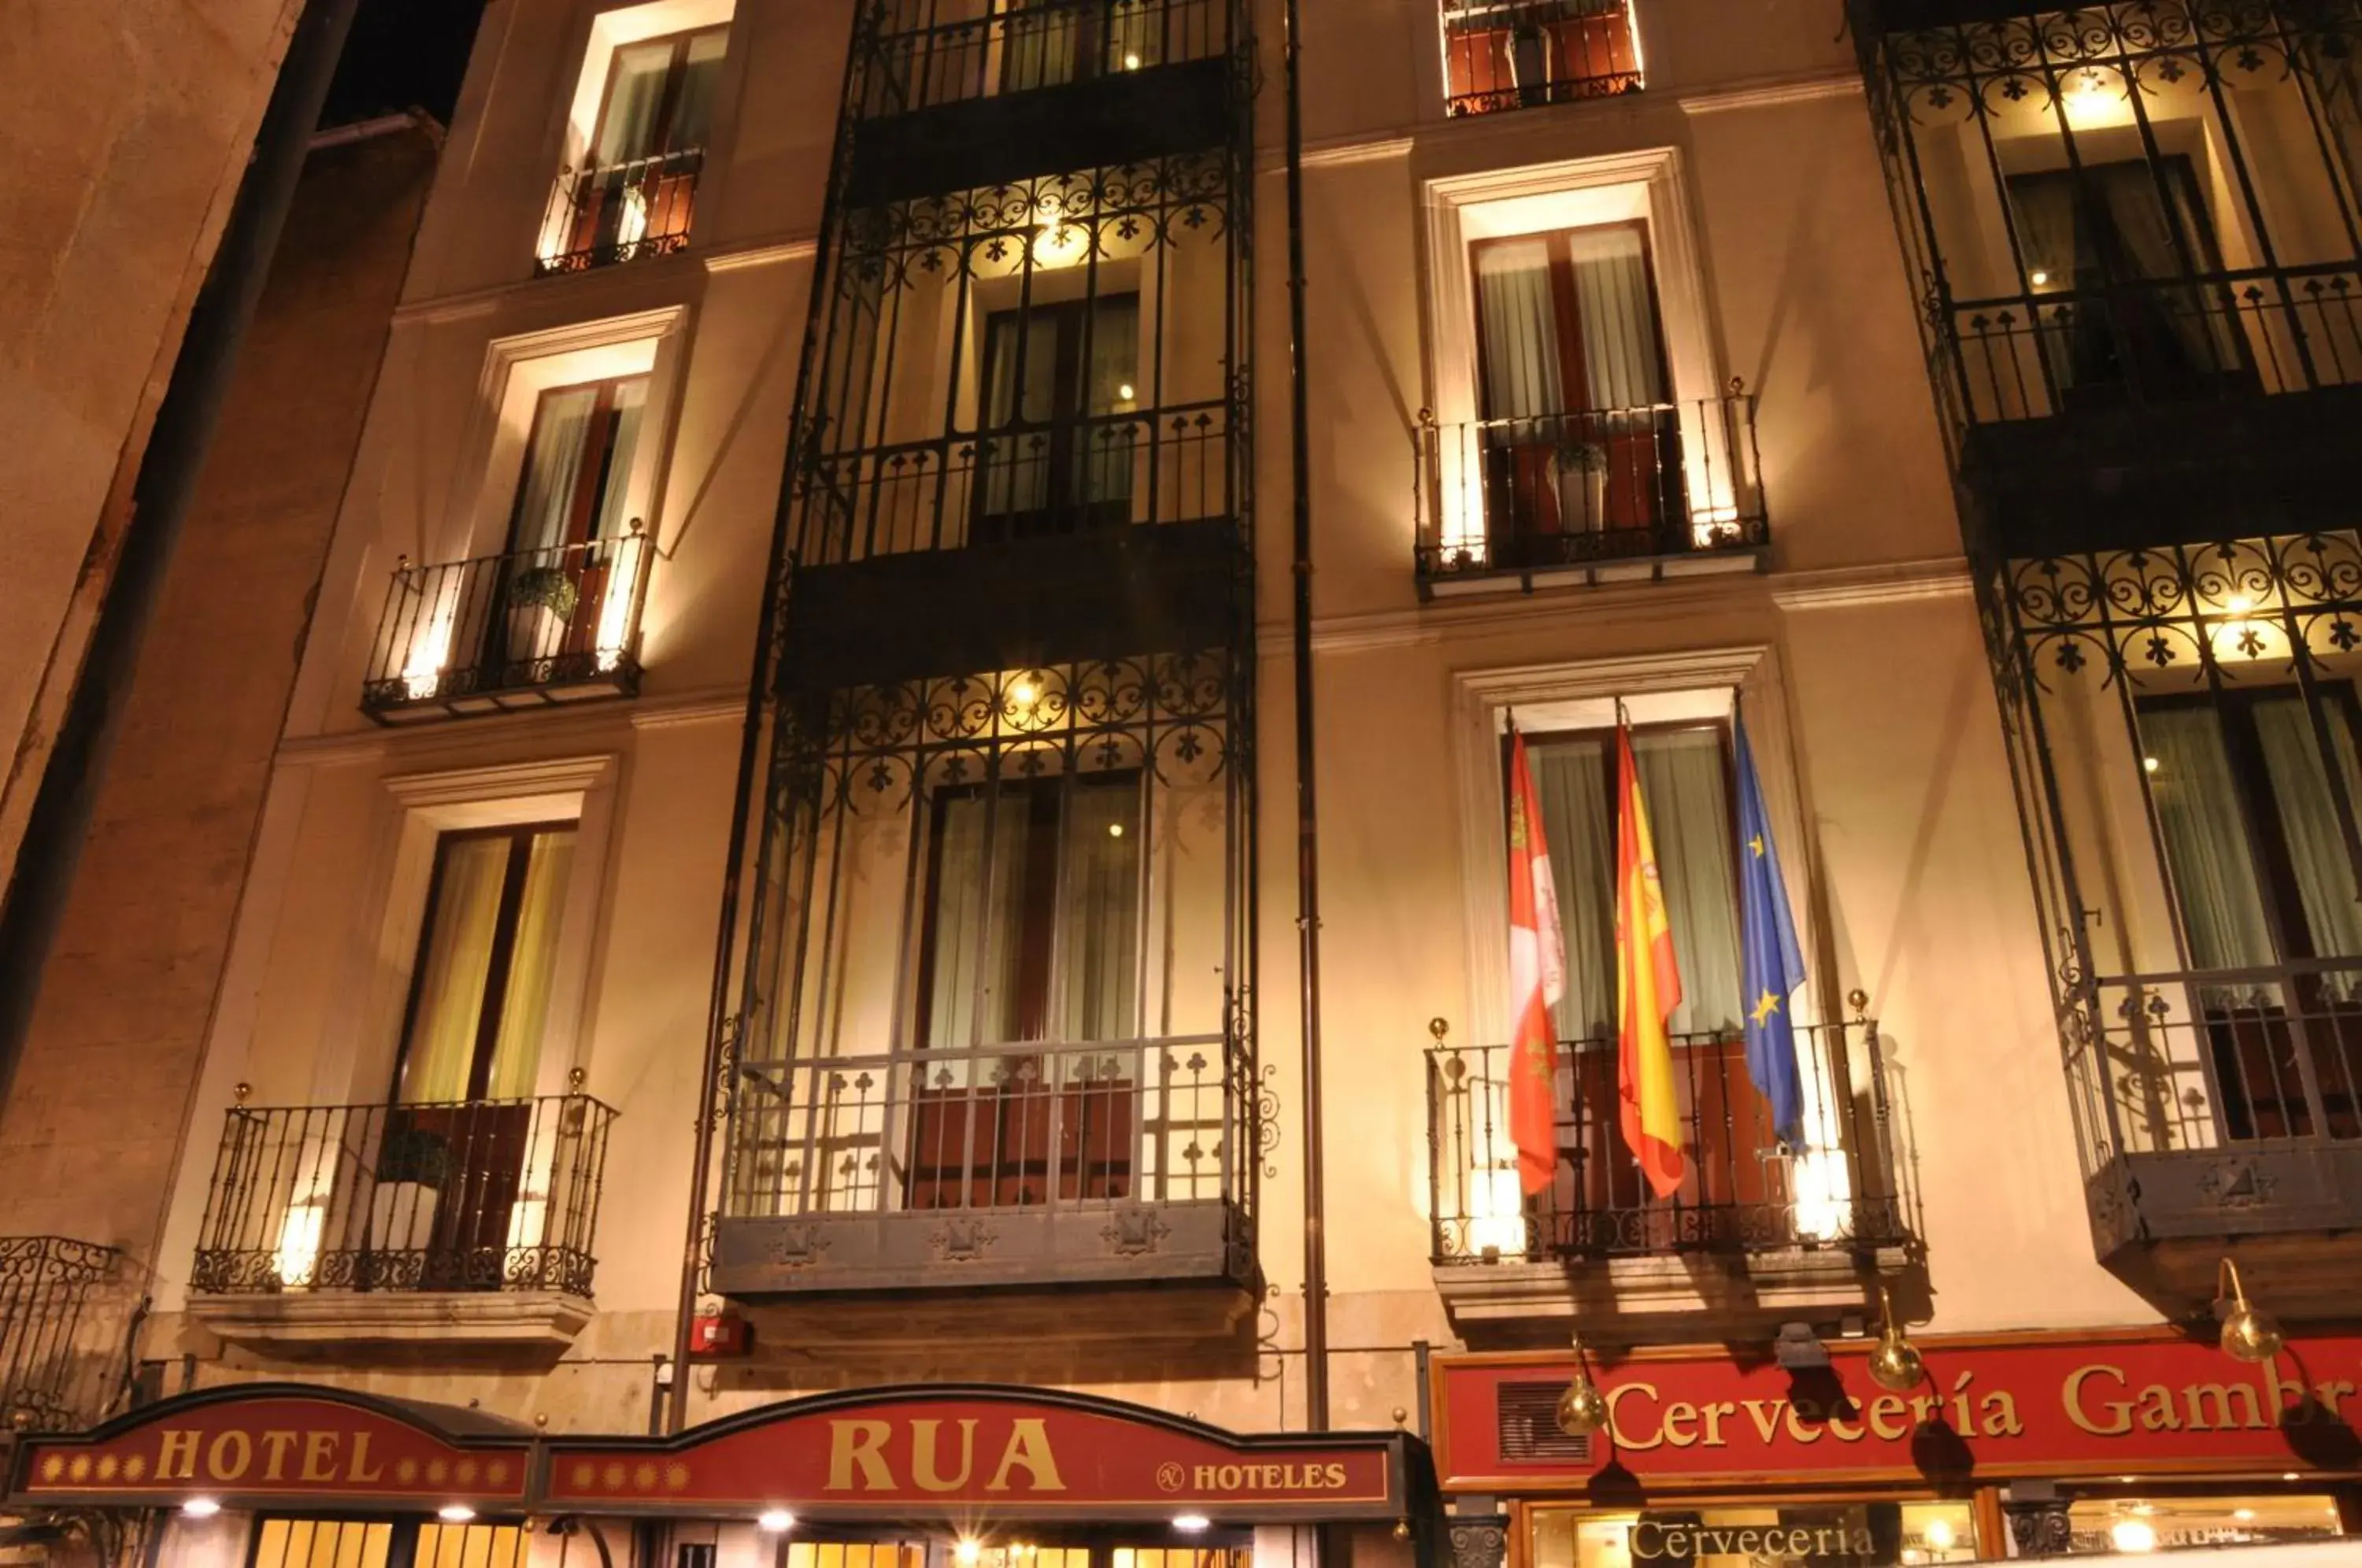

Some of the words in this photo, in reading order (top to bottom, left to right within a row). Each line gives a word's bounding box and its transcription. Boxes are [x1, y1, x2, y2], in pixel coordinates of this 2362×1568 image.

[1602, 1370, 2023, 1450] Cervecería
[2062, 1355, 2362, 1435] Gambr
[154, 1429, 384, 1482] HOTEL
[822, 1418, 1068, 1492] RUA
[1194, 1463, 1347, 1490] HOTELES
